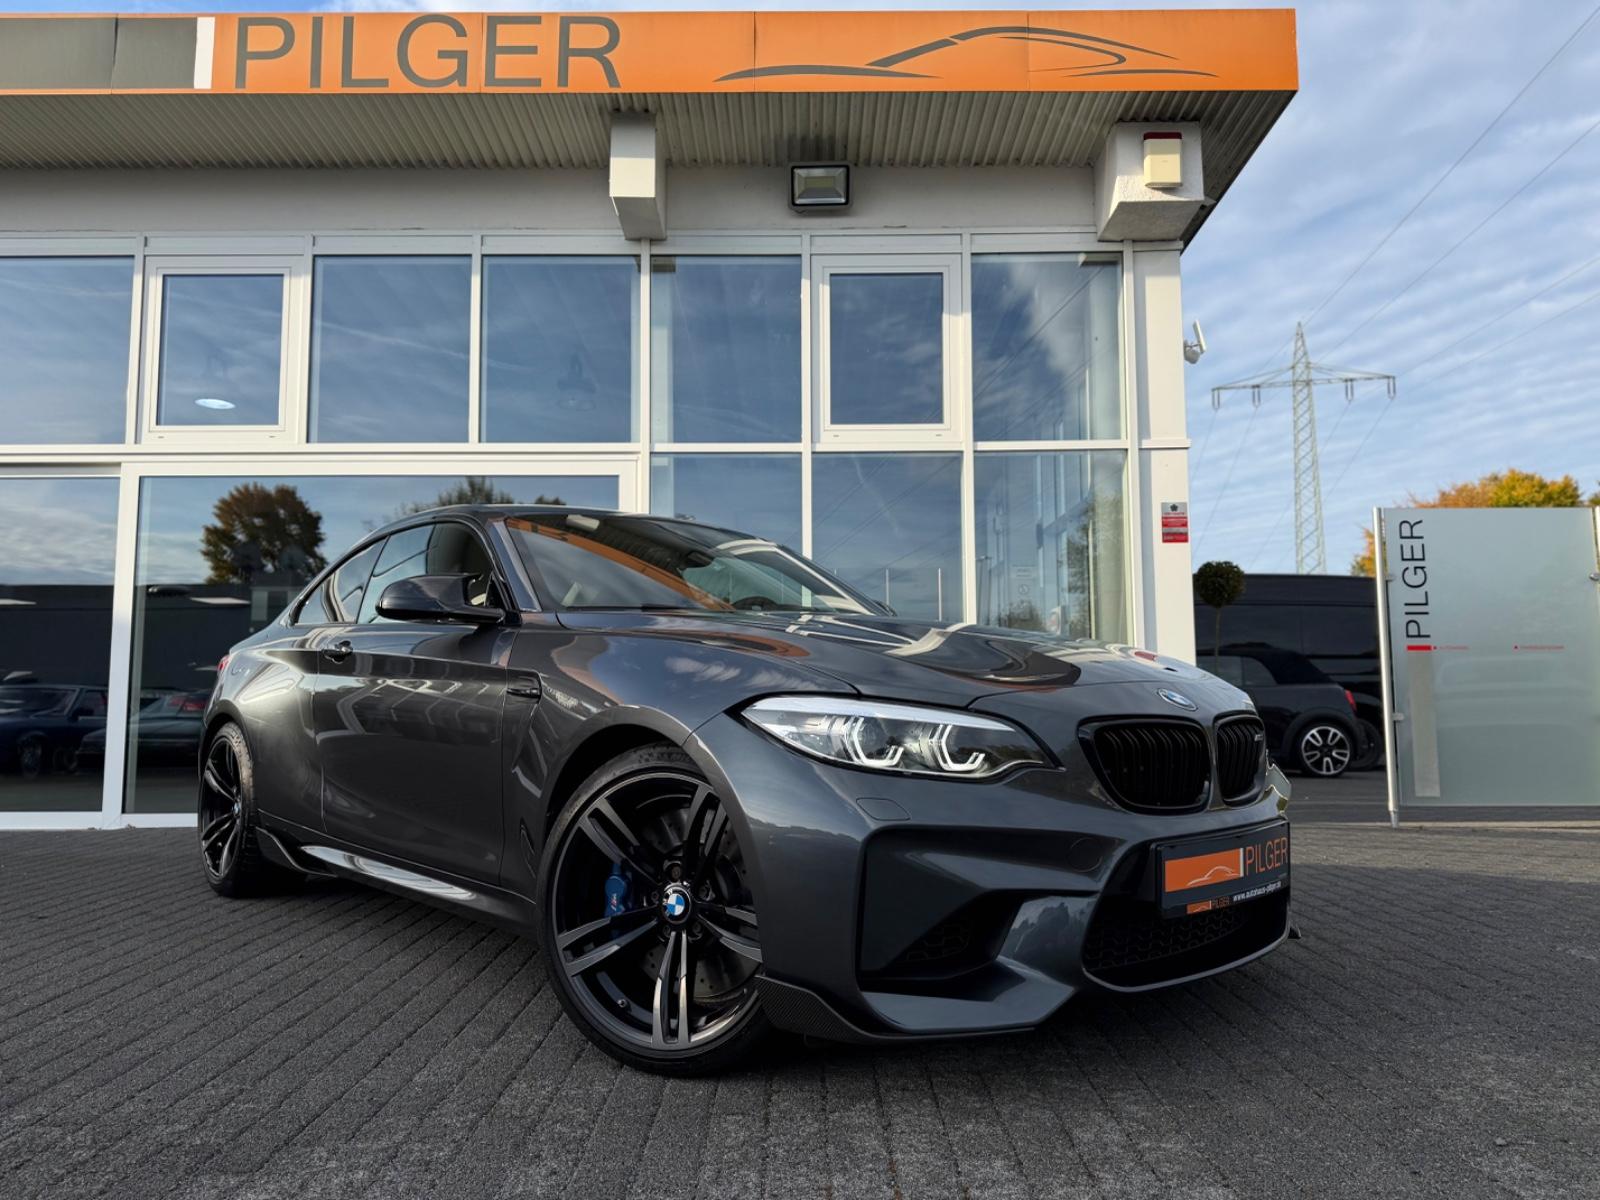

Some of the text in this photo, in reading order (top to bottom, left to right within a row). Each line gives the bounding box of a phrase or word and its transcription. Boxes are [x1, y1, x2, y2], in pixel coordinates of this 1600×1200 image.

[234, 14, 622, 88] PILGER
[1399, 518, 1431, 639] PILGER
[1246, 837, 1288, 876] PILGER
